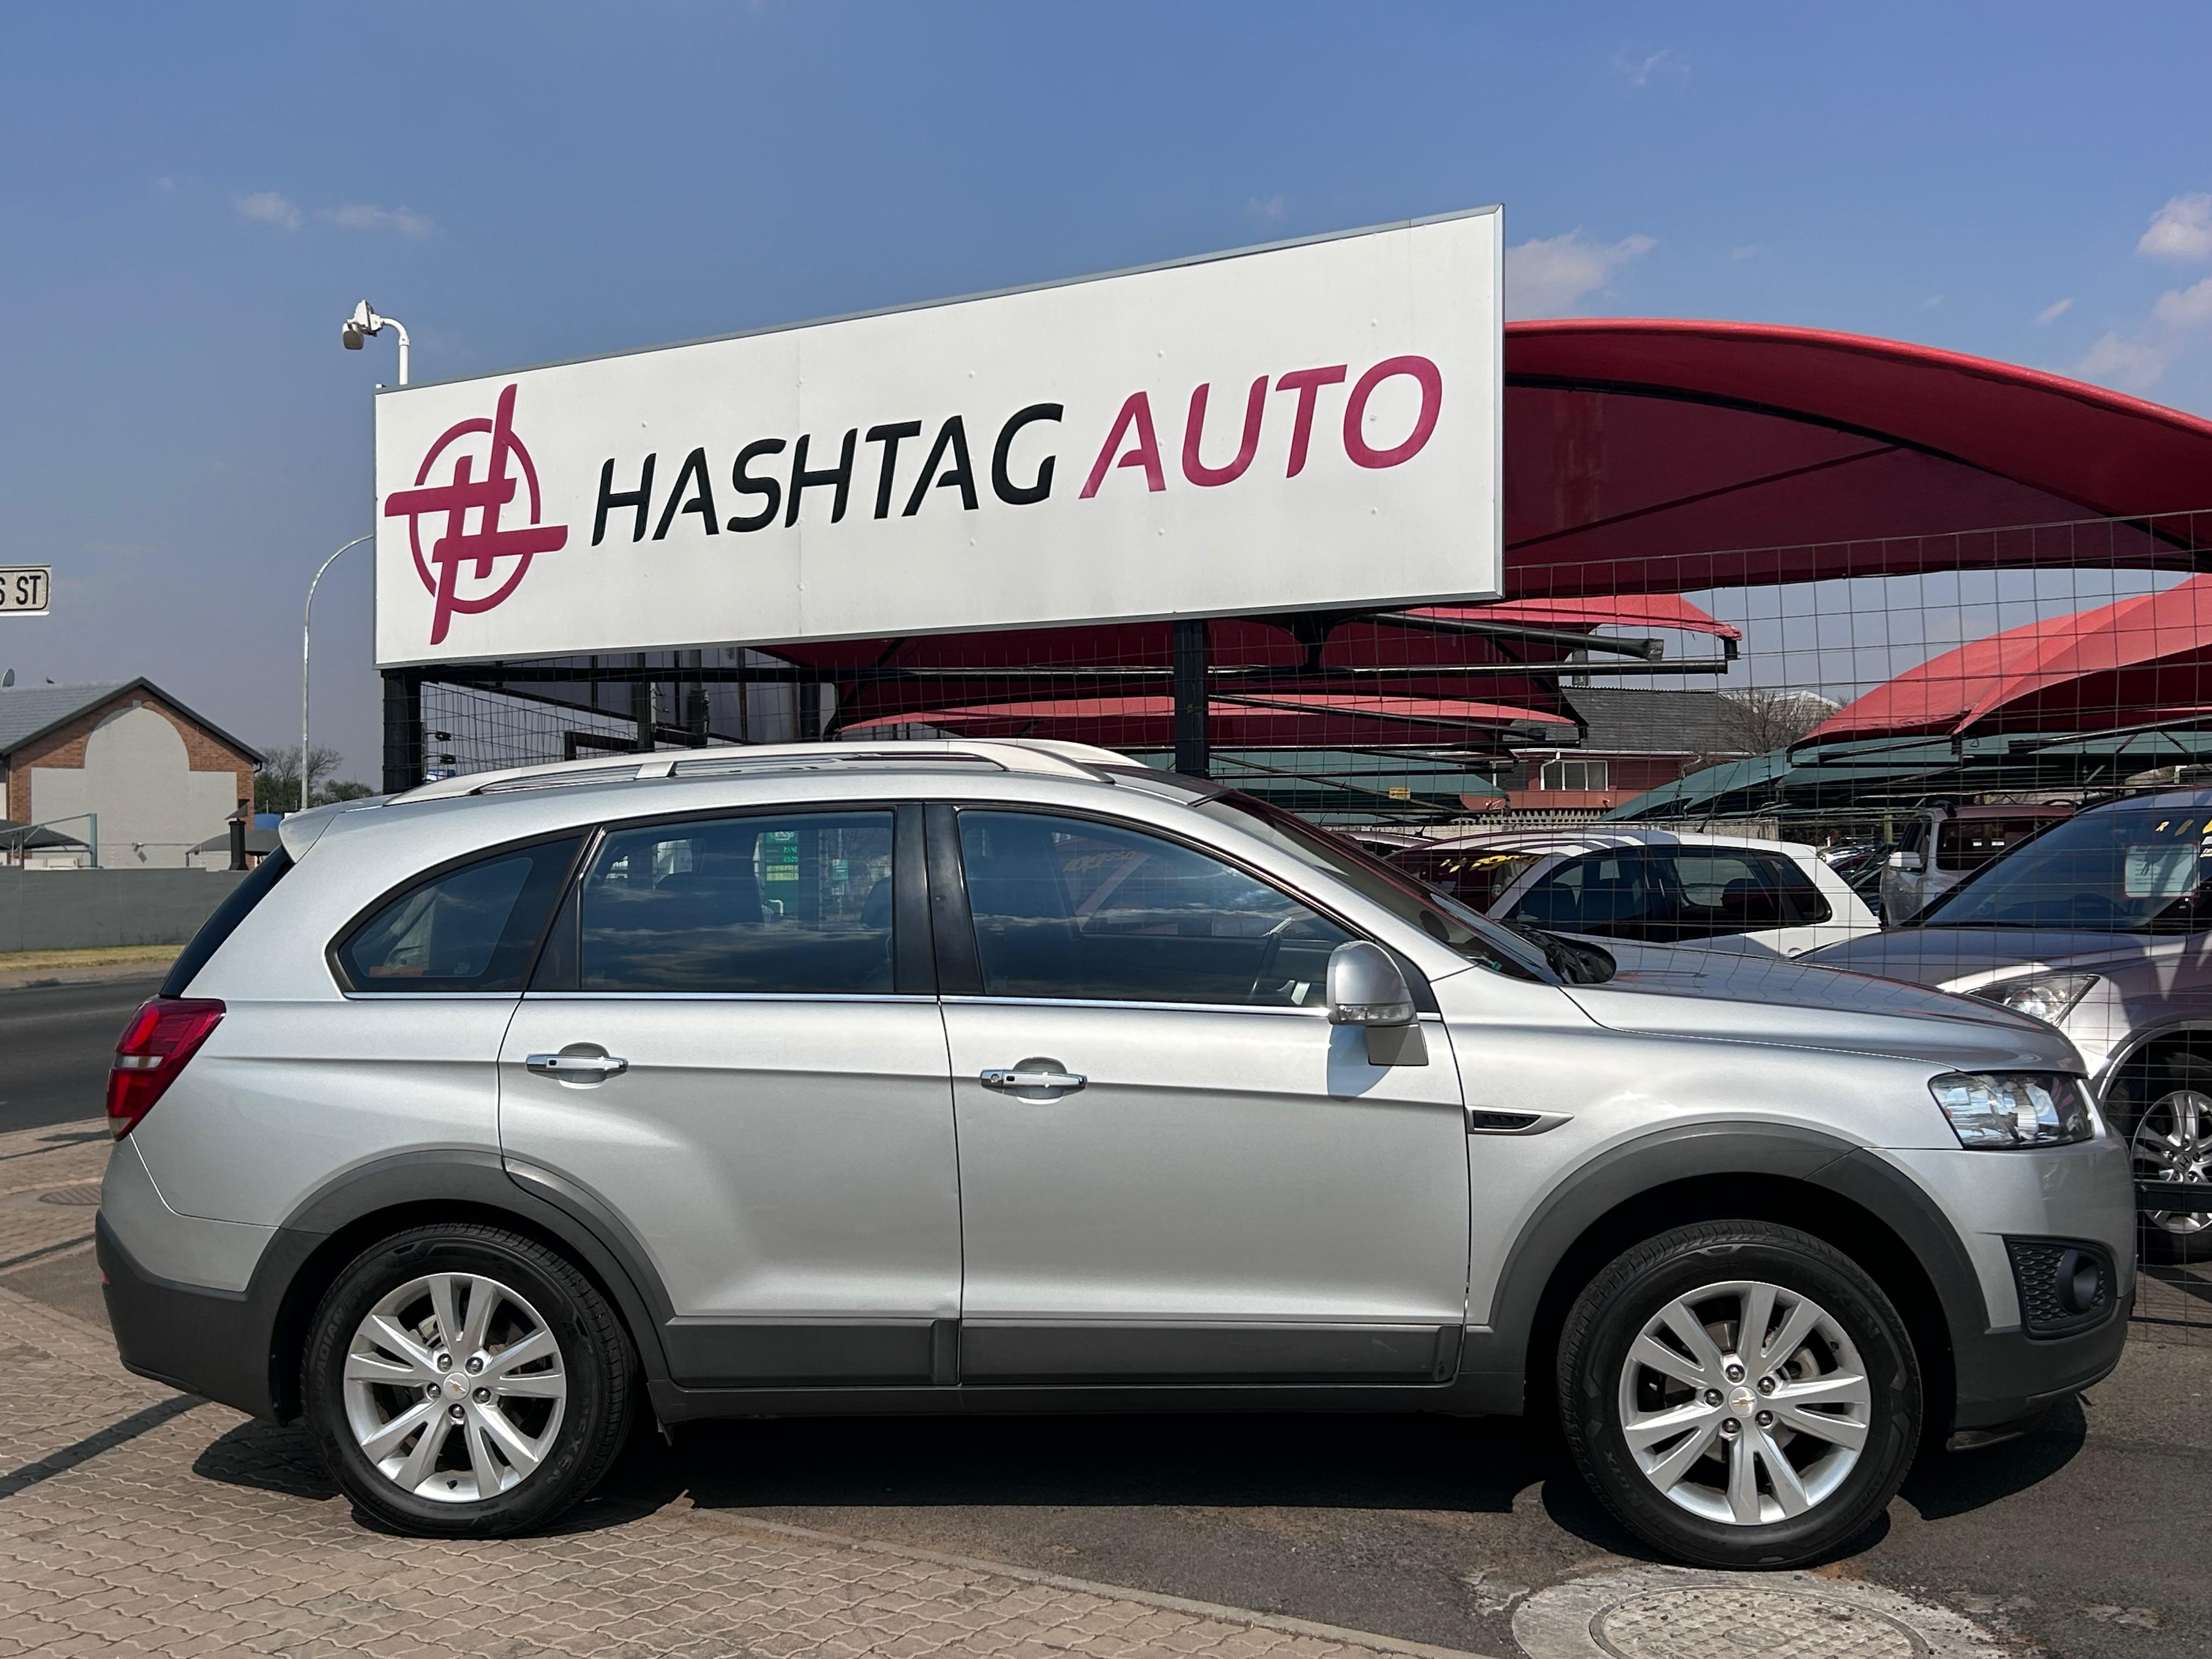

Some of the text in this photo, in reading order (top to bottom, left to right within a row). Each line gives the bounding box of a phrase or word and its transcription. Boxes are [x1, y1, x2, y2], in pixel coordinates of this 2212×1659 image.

[591, 355, 1443, 546] HASHTAG AUTO
[16, 575, 41, 605] ST
